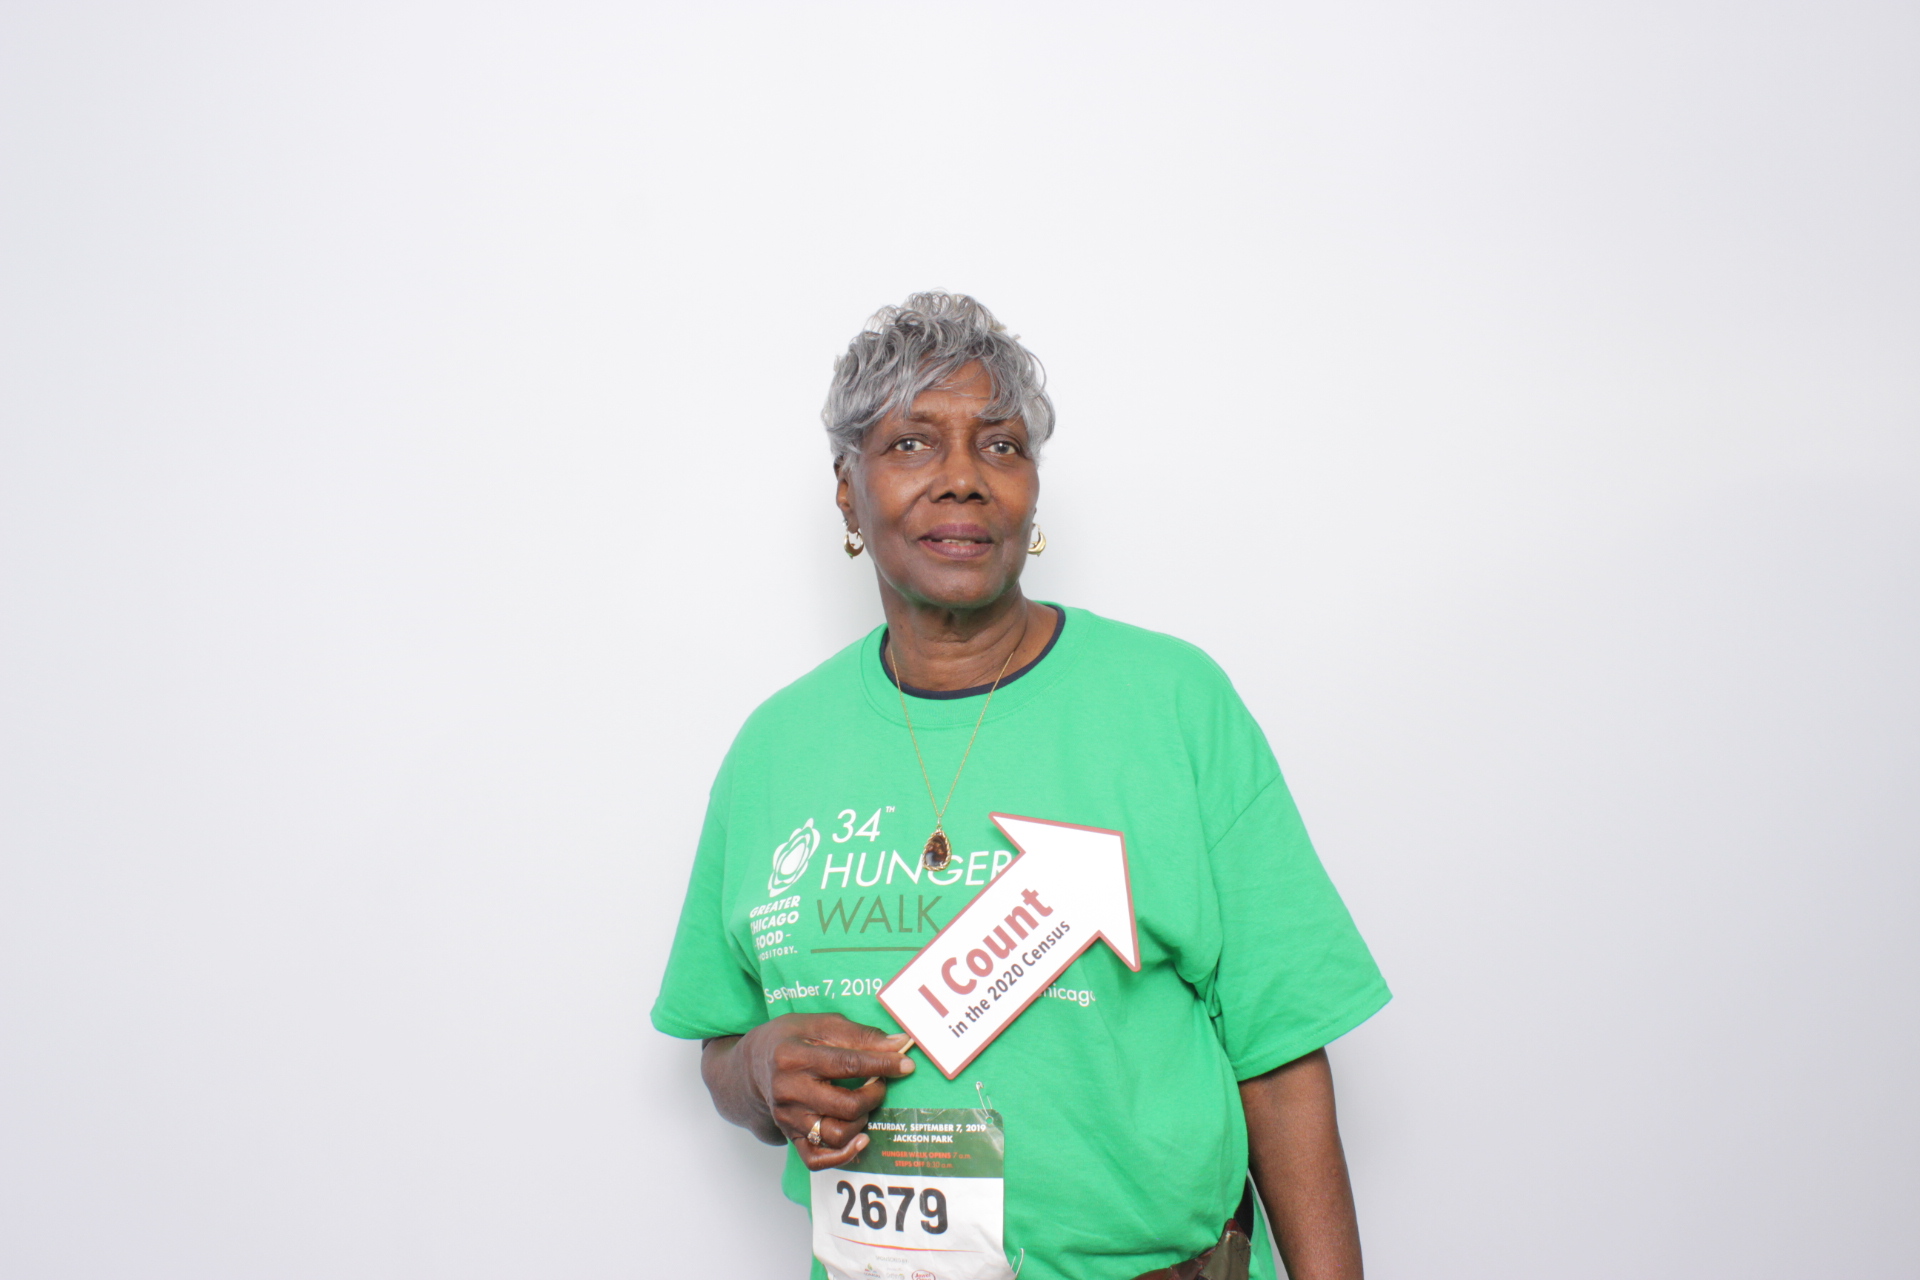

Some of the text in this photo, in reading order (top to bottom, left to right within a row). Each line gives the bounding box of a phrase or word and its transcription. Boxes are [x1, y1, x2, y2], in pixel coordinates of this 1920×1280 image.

[820, 849, 1012, 889] HUNGER
[749, 895, 801, 918] GREATER
[816, 895, 943, 935] WALK
[750, 910, 800, 935] HICAGO
[759, 945, 798, 961] OSITORY
[918, 888, 1054, 1018] I Count
[822, 979, 836, 999] 7,
[840, 978, 883, 997] 2019
[948, 921, 1071, 1038] in the 2020 Census
[867, 1122, 987, 1133] SATURDAY, SEPTEMBER 7, 2019
[893, 1134, 954, 1143] JACKSON PARK
[836, 1180, 949, 1235] 2679
